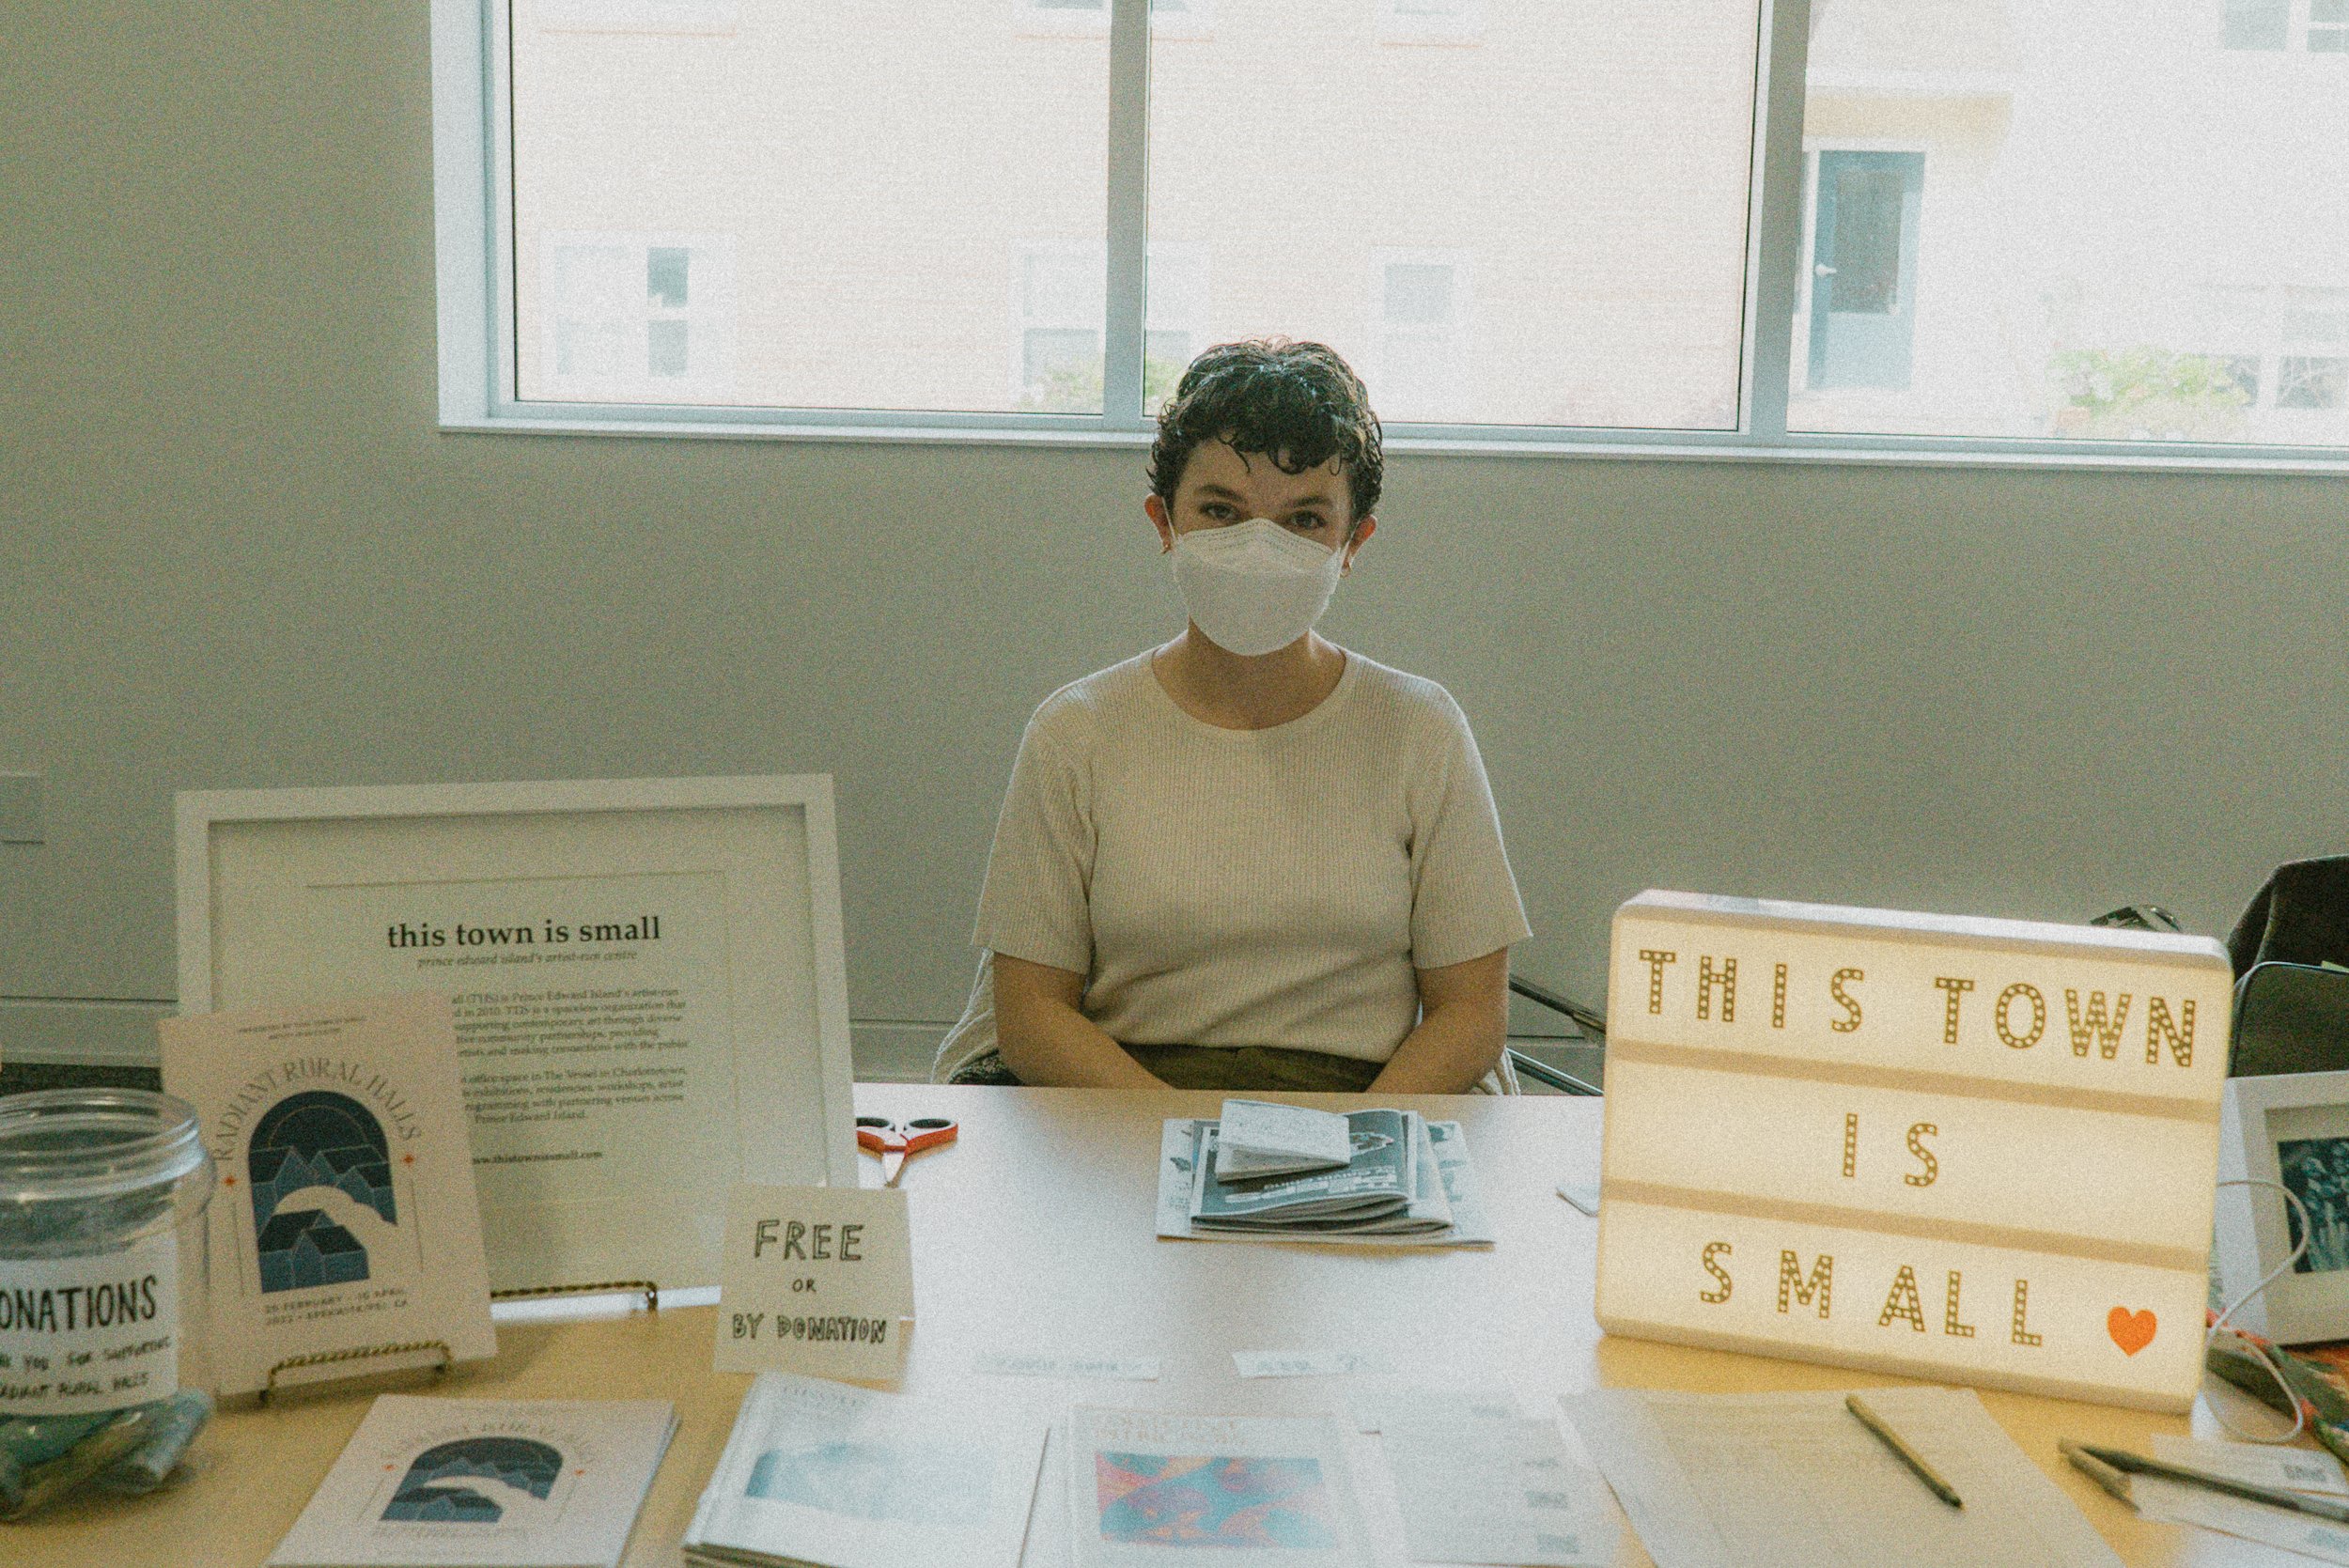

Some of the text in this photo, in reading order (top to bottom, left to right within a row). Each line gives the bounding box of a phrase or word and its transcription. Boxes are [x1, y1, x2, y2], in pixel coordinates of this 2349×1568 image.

[387, 915, 661, 948] this town is small
[416, 950, 638, 969] prince edward island's artist-run centre
[512, 992, 544, 1002] Prince
[547, 990, 587, 1001] Edward
[590, 988, 630, 999] Island's
[631, 987, 678, 998] artist-run
[601, 1001, 664, 1013] organization
[666, 1000, 687, 1009] that
[1639, 949, 2196, 1068] THIS TOWN
[512, 1017, 583, 1031] contemporary
[587, 1017, 601, 1025] art
[603, 1015, 645, 1026] through
[487, 1046, 506, 1056] and
[510, 1045, 549, 1057] making
[614, 1041, 637, 1050] with
[639, 1040, 655, 1049] the
[544, 1070, 563, 1079] The
[212, 1057, 423, 1161] RADIANT RURAL HALLS
[532, 1097, 555, 1107] with
[474, 1113, 506, 1124] Prince
[509, 1110, 551, 1123] Edward
[1842, 1113, 1939, 1188] IS
[754, 1219, 864, 1261] FREE
[792, 1278, 817, 1294] OR
[1700, 1242, 2043, 1348] SMALL
[0, 1274, 157, 1333] ONATIONS
[732, 1313, 887, 1344] BY DONATION
